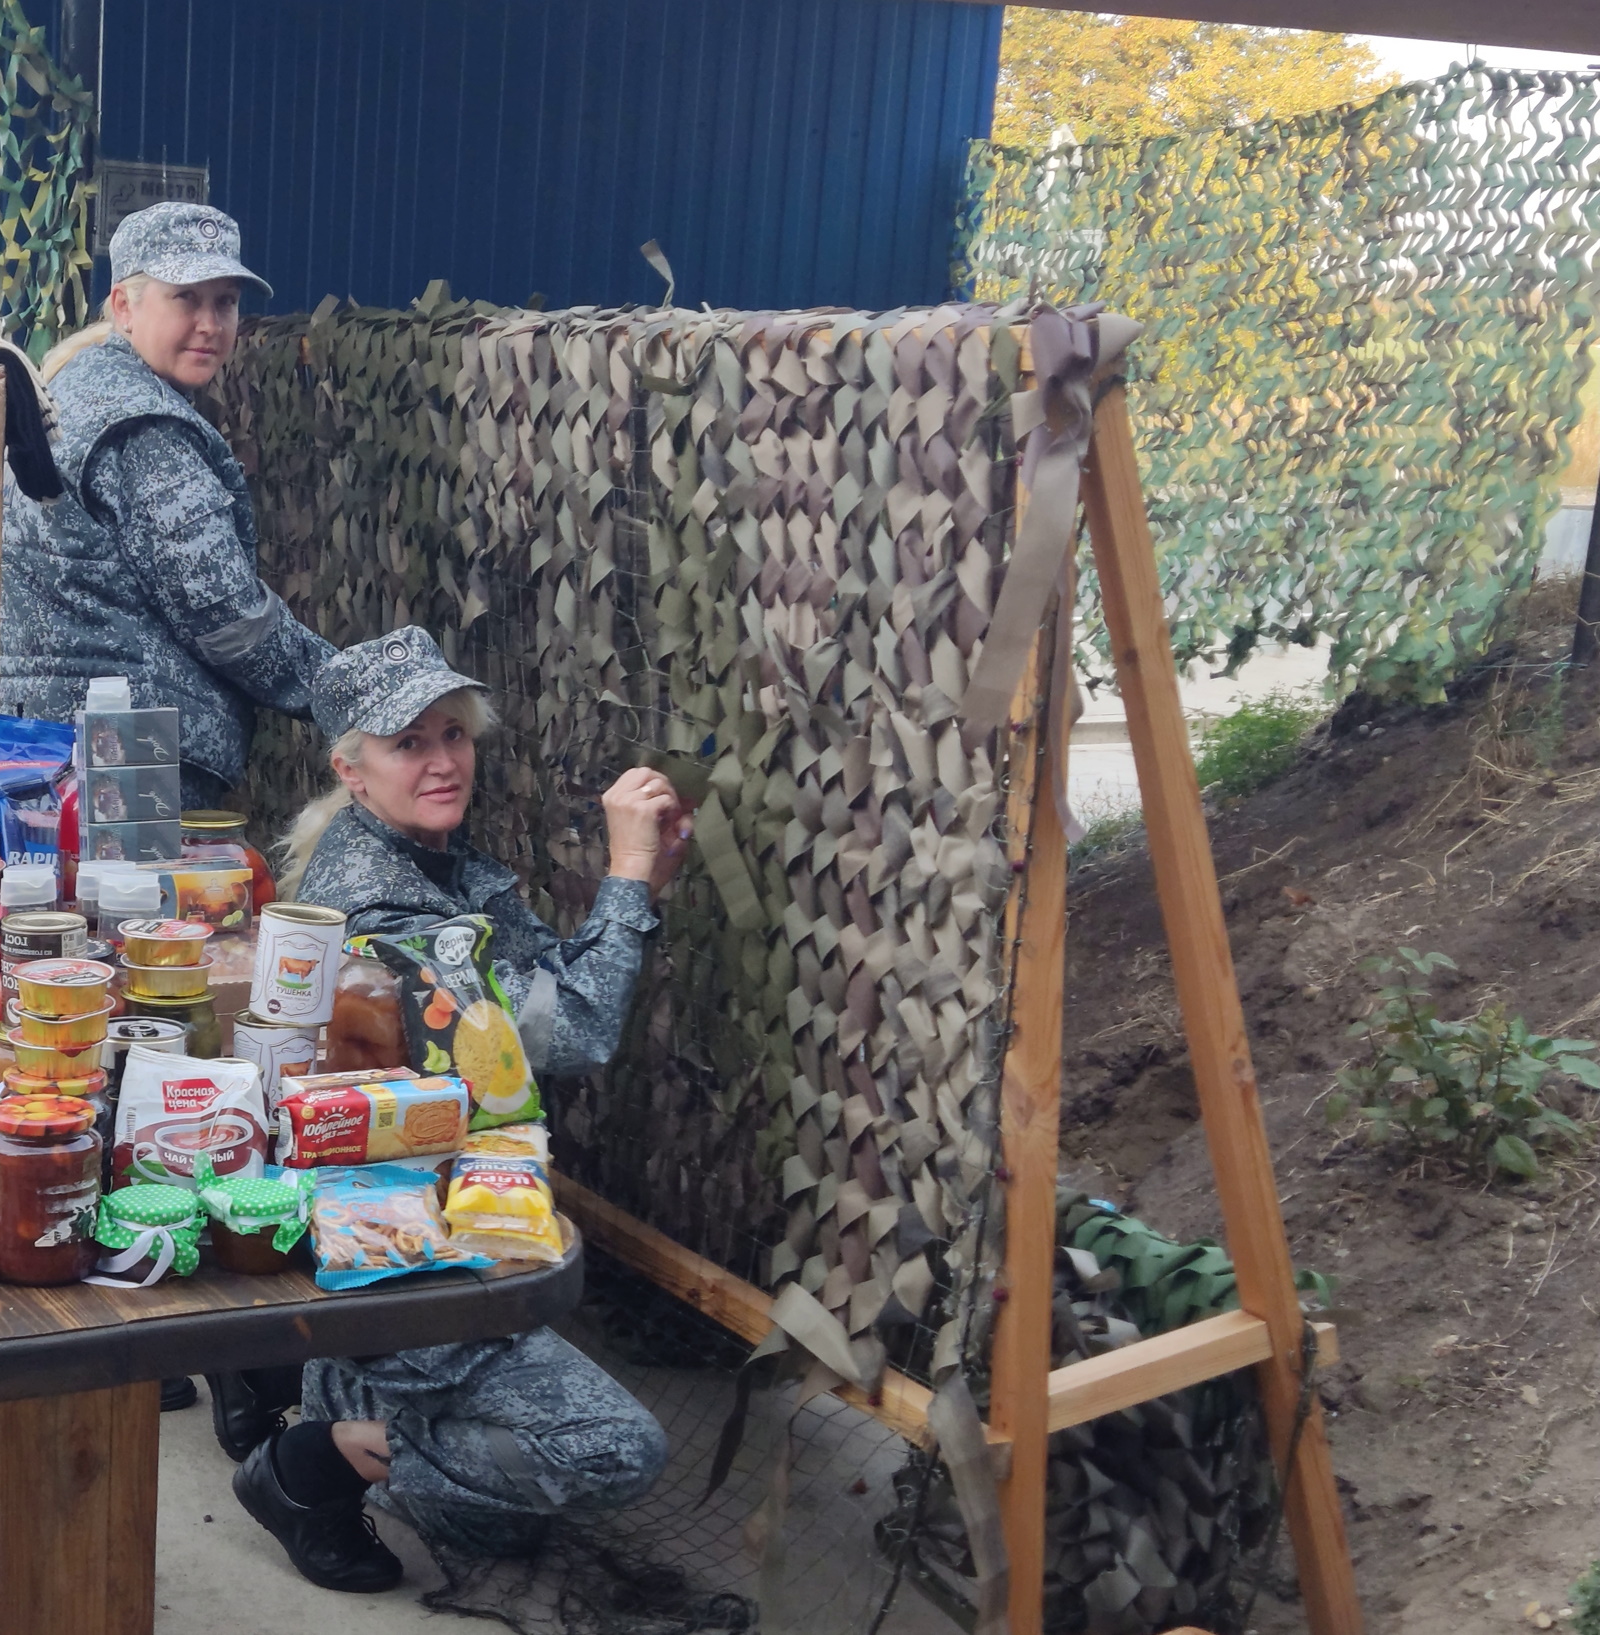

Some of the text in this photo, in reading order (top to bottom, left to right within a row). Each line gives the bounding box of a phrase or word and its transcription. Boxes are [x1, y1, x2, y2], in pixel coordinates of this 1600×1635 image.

[166, 1084, 216, 1100] Красная
[168, 1099, 197, 1111] цена
[302, 1114, 365, 1137] Юбилейное
[164, 1152, 187, 1165] ЧАЙ
